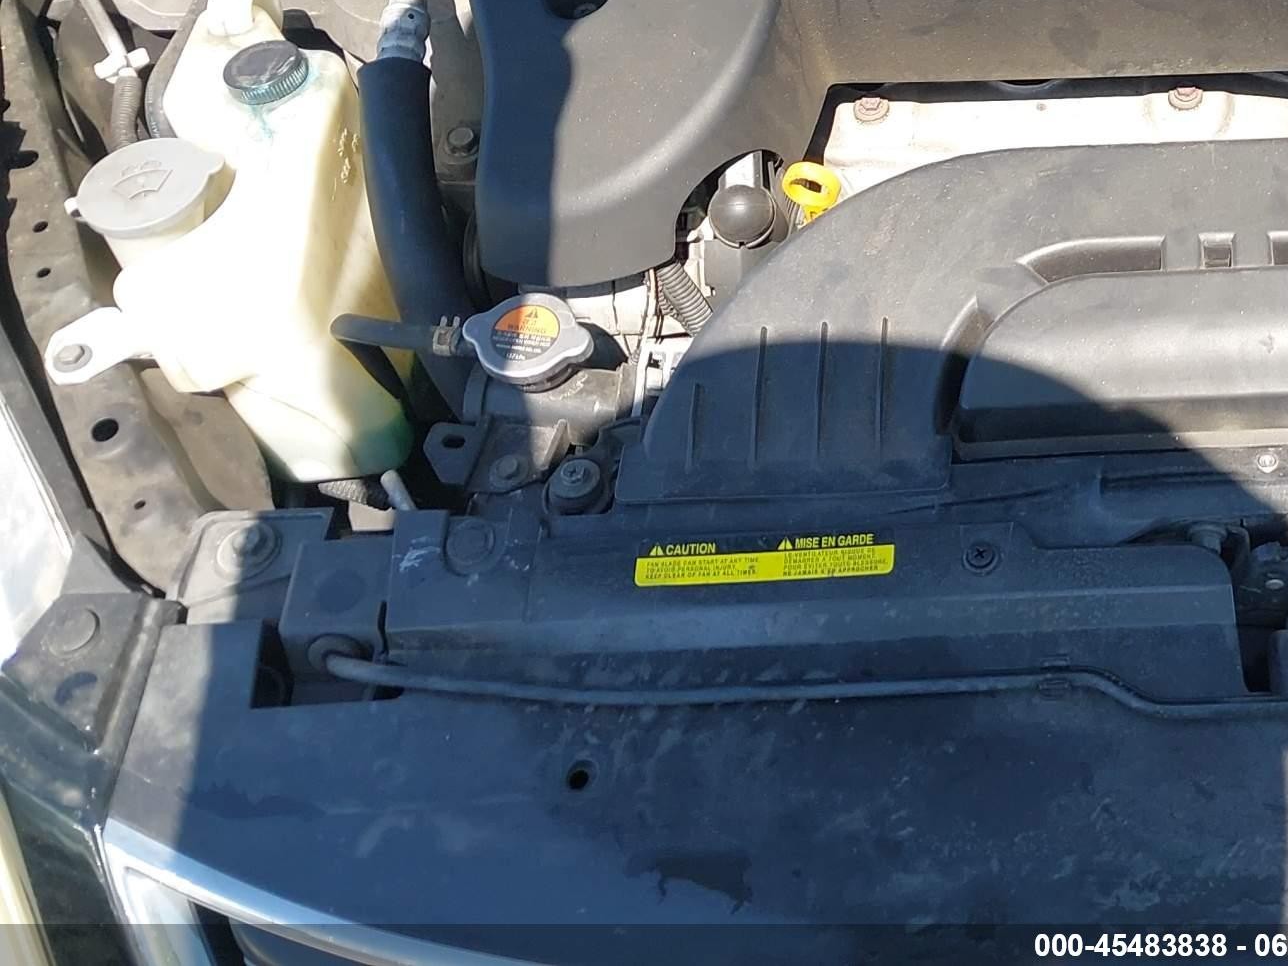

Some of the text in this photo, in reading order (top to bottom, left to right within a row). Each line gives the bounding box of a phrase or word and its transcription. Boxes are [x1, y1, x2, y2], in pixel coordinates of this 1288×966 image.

[795, 534, 874, 549] MISE EN GARDE
[665, 543, 716, 555] CAUTION
